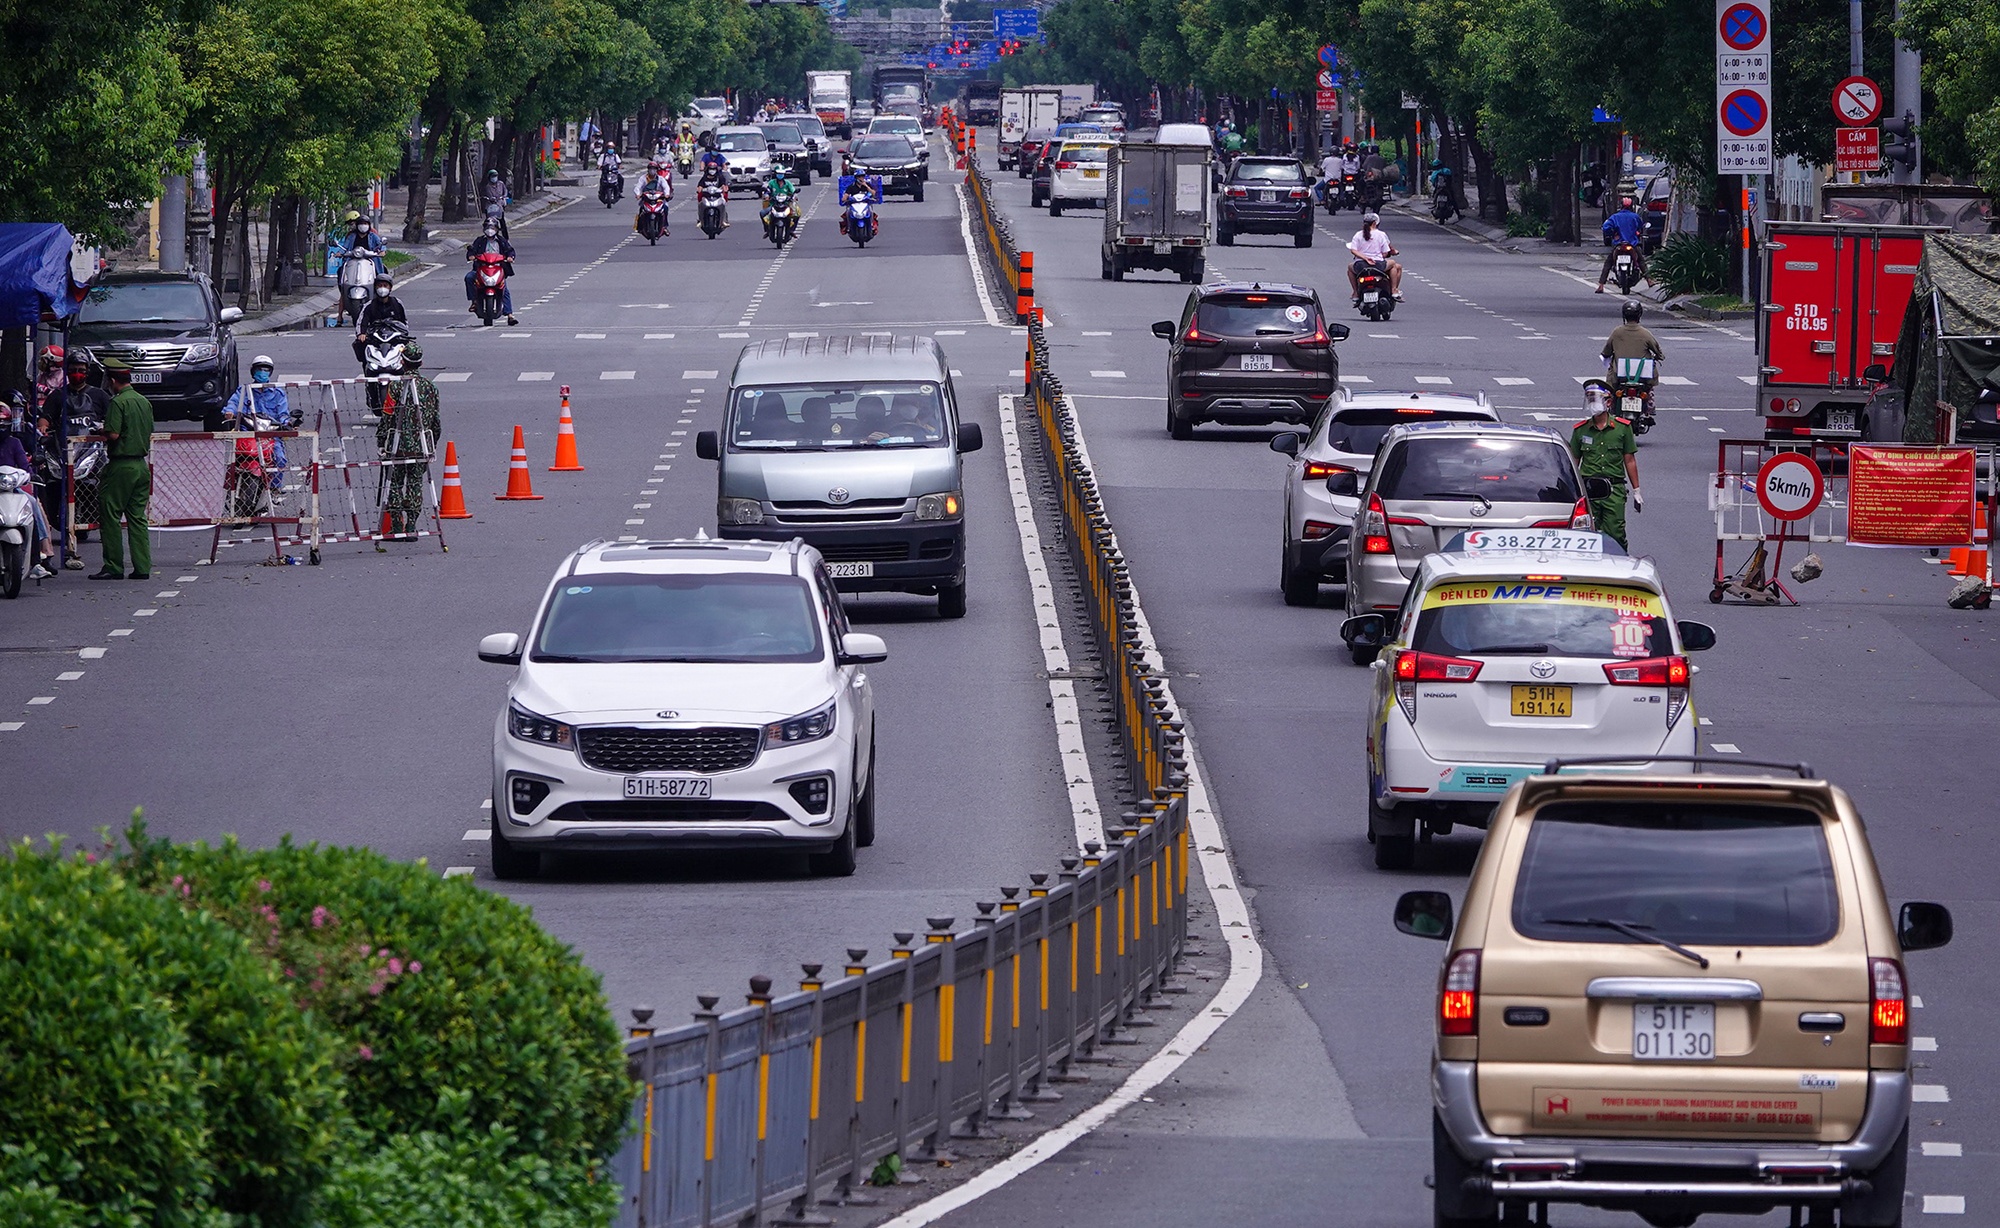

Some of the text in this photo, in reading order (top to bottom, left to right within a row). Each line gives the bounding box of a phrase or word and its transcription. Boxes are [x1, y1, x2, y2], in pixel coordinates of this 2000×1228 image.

[1724, 58, 1740, 67] 6:00
[1747, 58, 1763, 67] 9:00
[1721, 72, 1740, 81] 16:00
[1748, 72, 1767, 81] 19:00
[1848, 129, 1867, 142] CẤM
[1794, 303, 1818, 318] 51D
[1786, 317, 1828, 332] 618.95
[1249, 355, 1265, 363] 51H
[1833, 415, 1849, 424] 51D
[1768, 476, 1811, 499] 5km/h
[1497, 535, 1598, 550] 38.27 27 27
[1440, 585, 1648, 608] ĐÈN LED MPE THIẾT BỊ ĐIỆN
[1610, 623, 1652, 647] 10%
[1528, 687, 1555, 700] 51H
[1519, 701, 1566, 715] 191.14
[1439, 767, 1453, 778] NEW
[627, 779, 708, 796] 51H-587.72
[1652, 1003, 1693, 1030] 51F
[1636, 1031, 1713, 1057] 011.30
[1602, 1097, 1624, 1107] POWER
[1690, 1098, 1734, 1108] MAINTENANCE
[1736, 1100, 1750, 1109] AND
[1751, 1100, 1773, 1109] REPAIR
[1774, 1101, 1798, 1110] CENTER
